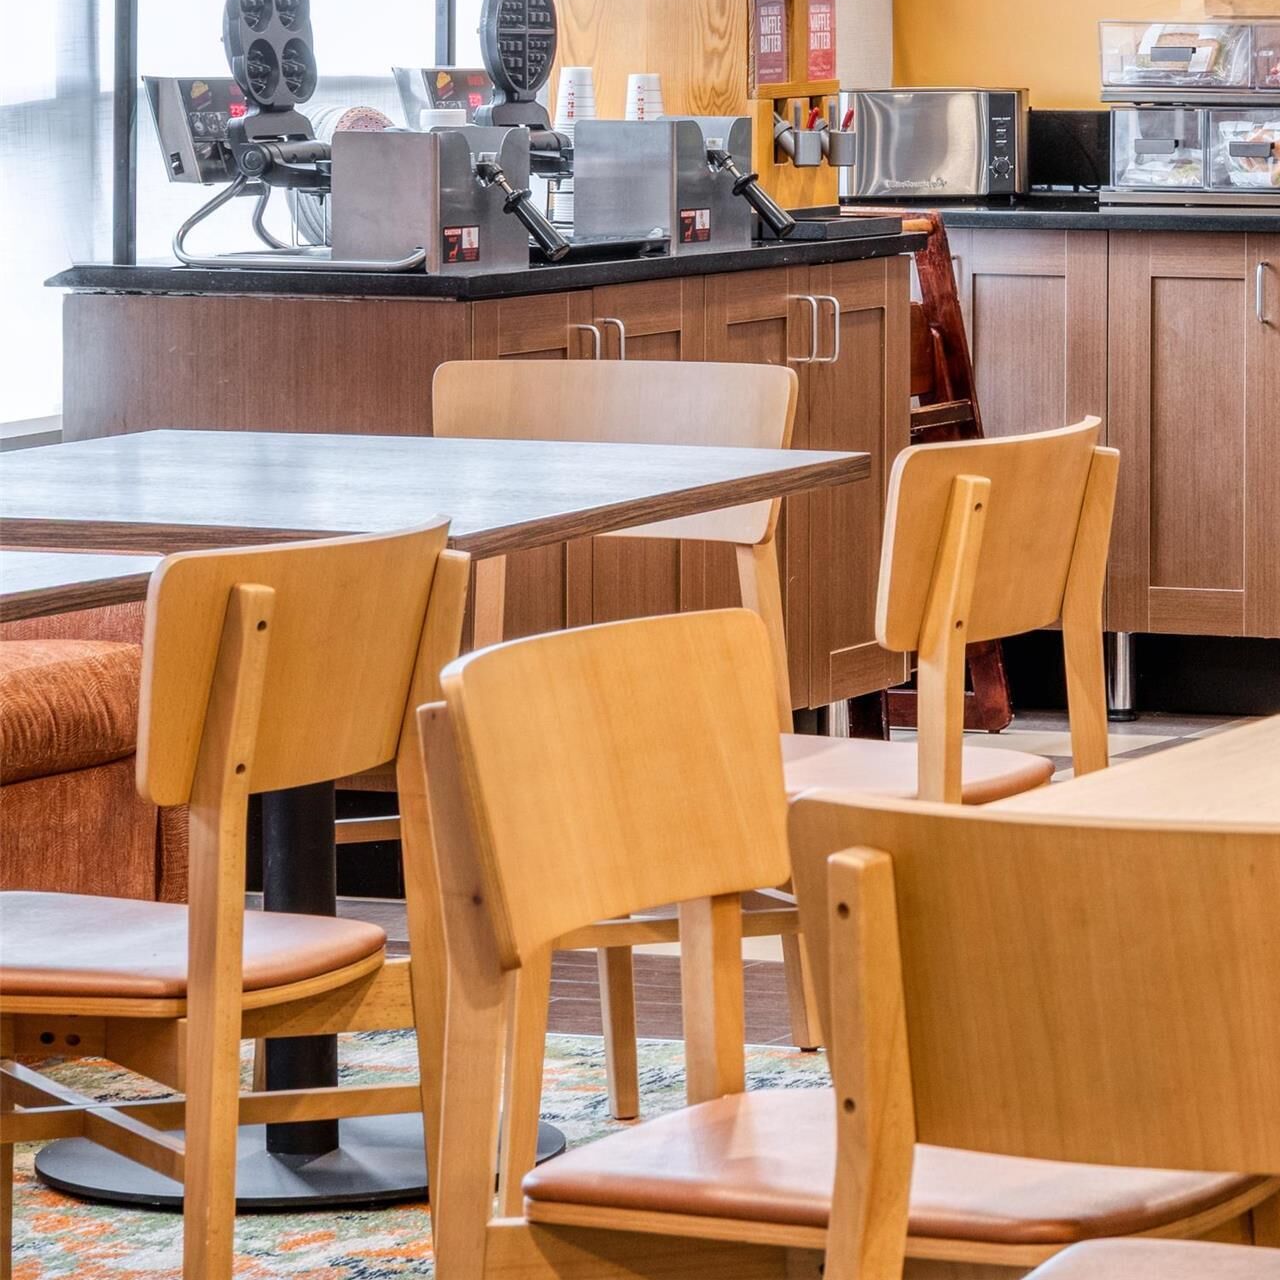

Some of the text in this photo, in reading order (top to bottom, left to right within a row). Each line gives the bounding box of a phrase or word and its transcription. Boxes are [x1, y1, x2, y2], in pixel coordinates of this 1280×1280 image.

[760, 15, 782, 34] WAFFLE
[810, 13, 831, 32] WAFFLE
[760, 34, 782, 54] BATTER
[810, 32, 832, 51] BATTER
